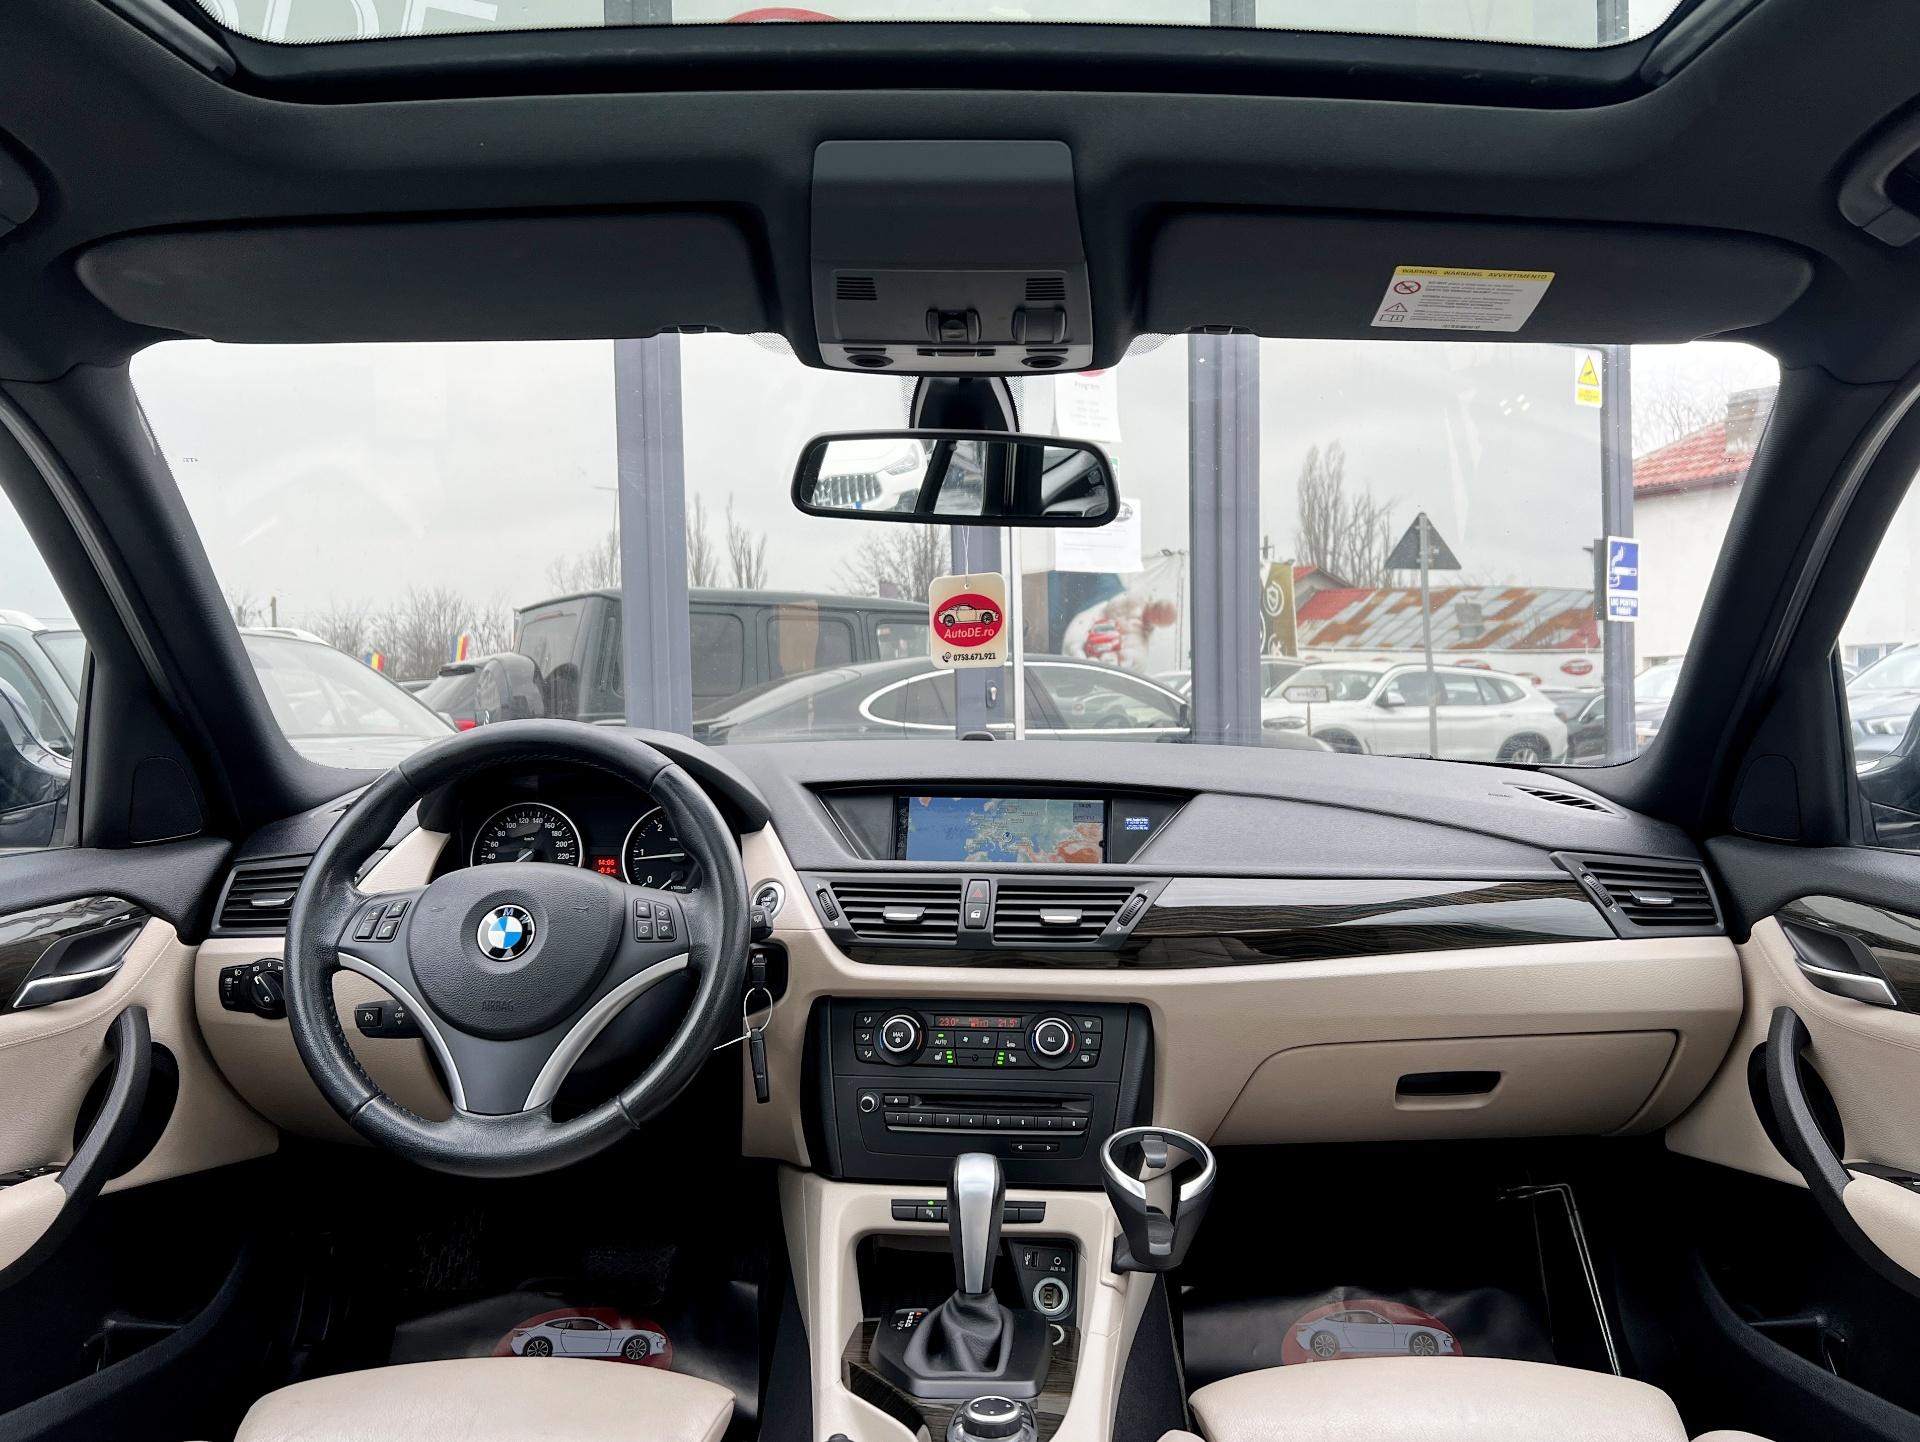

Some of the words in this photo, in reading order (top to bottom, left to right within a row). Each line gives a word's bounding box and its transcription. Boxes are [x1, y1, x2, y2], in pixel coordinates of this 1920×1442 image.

[944, 627, 995, 639] AutoDE.ro
[657, 823, 663, 832] 2
[640, 848, 644, 856] 1
[647, 875, 653, 884] 0
[482, 1000, 514, 1011] AIRBAG
